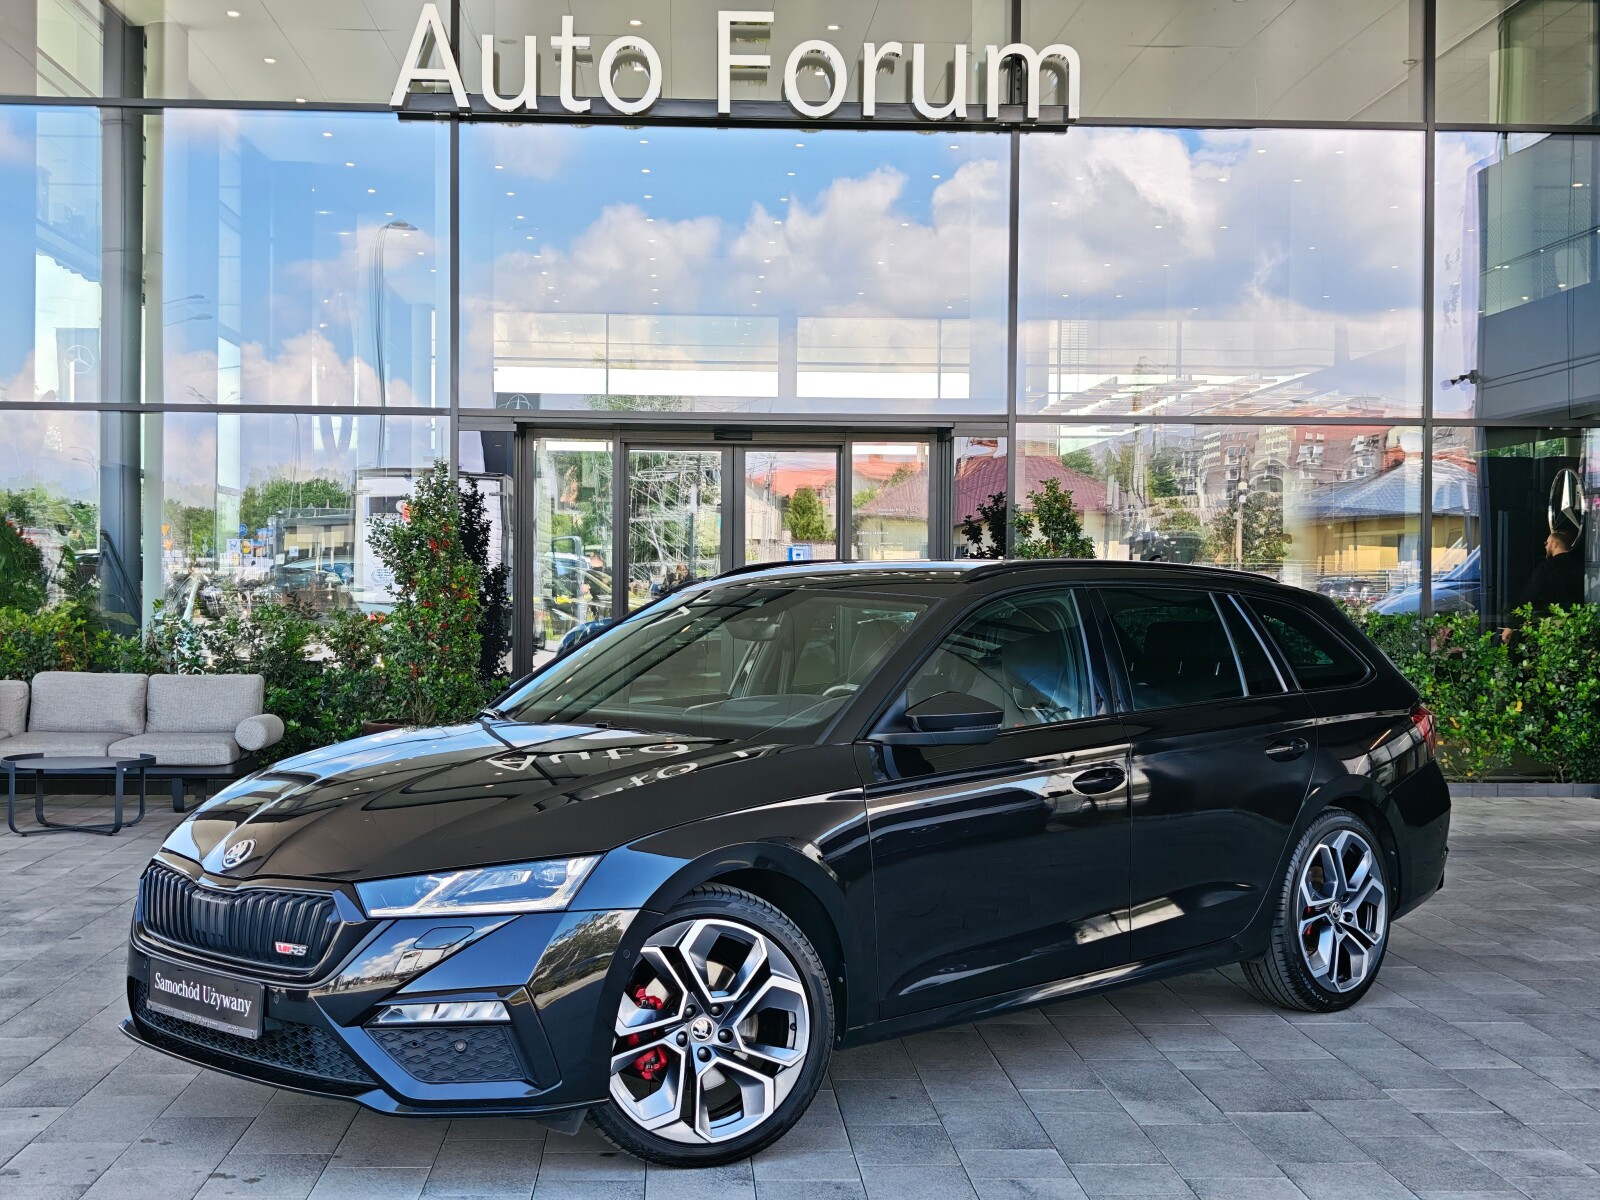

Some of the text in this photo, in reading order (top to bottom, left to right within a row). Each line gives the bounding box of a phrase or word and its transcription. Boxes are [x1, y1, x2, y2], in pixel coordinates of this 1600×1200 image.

[389, 3, 1081, 120] Auto Forum
[154, 972, 252, 1017] Samochód Używany
